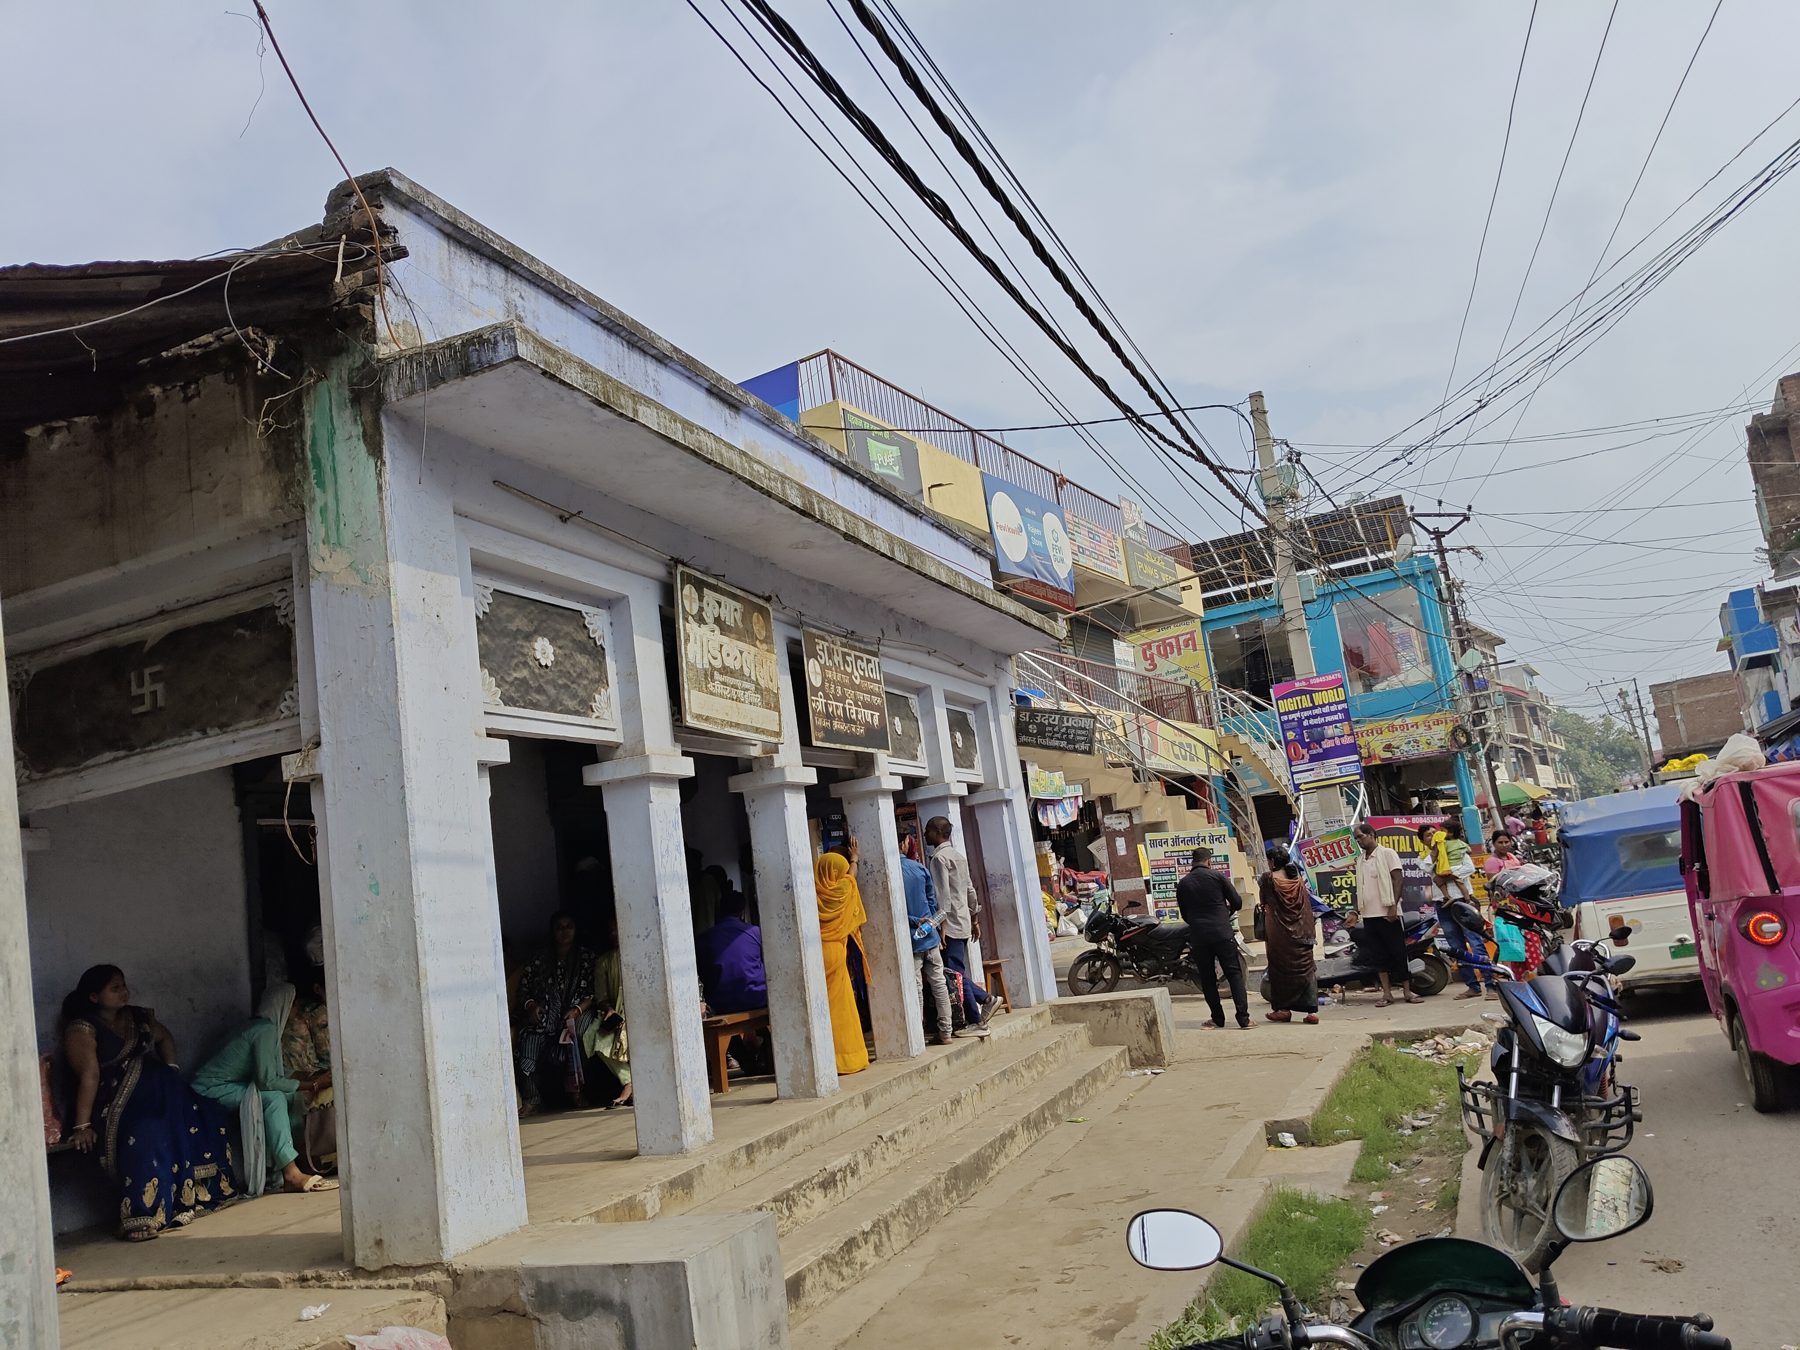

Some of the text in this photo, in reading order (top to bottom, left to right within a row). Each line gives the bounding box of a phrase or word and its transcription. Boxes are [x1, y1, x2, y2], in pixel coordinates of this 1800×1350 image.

[703, 587, 744, 628] कुमार
[686, 615, 757, 682] मेडिकल
[1141, 629, 1197, 672] दुकान
[828, 695, 843, 718] रोग
[1278, 688, 1345, 713] DIGITAL WORLD
[1034, 712, 1060, 725] उदय
[1061, 715, 1095, 729] प्रकाश
[1149, 833, 1227, 848] सावन ऑनलाईन सेन्टर
[1301, 835, 1355, 868] अंसार
[1376, 836, 1412, 852] IGITAL
